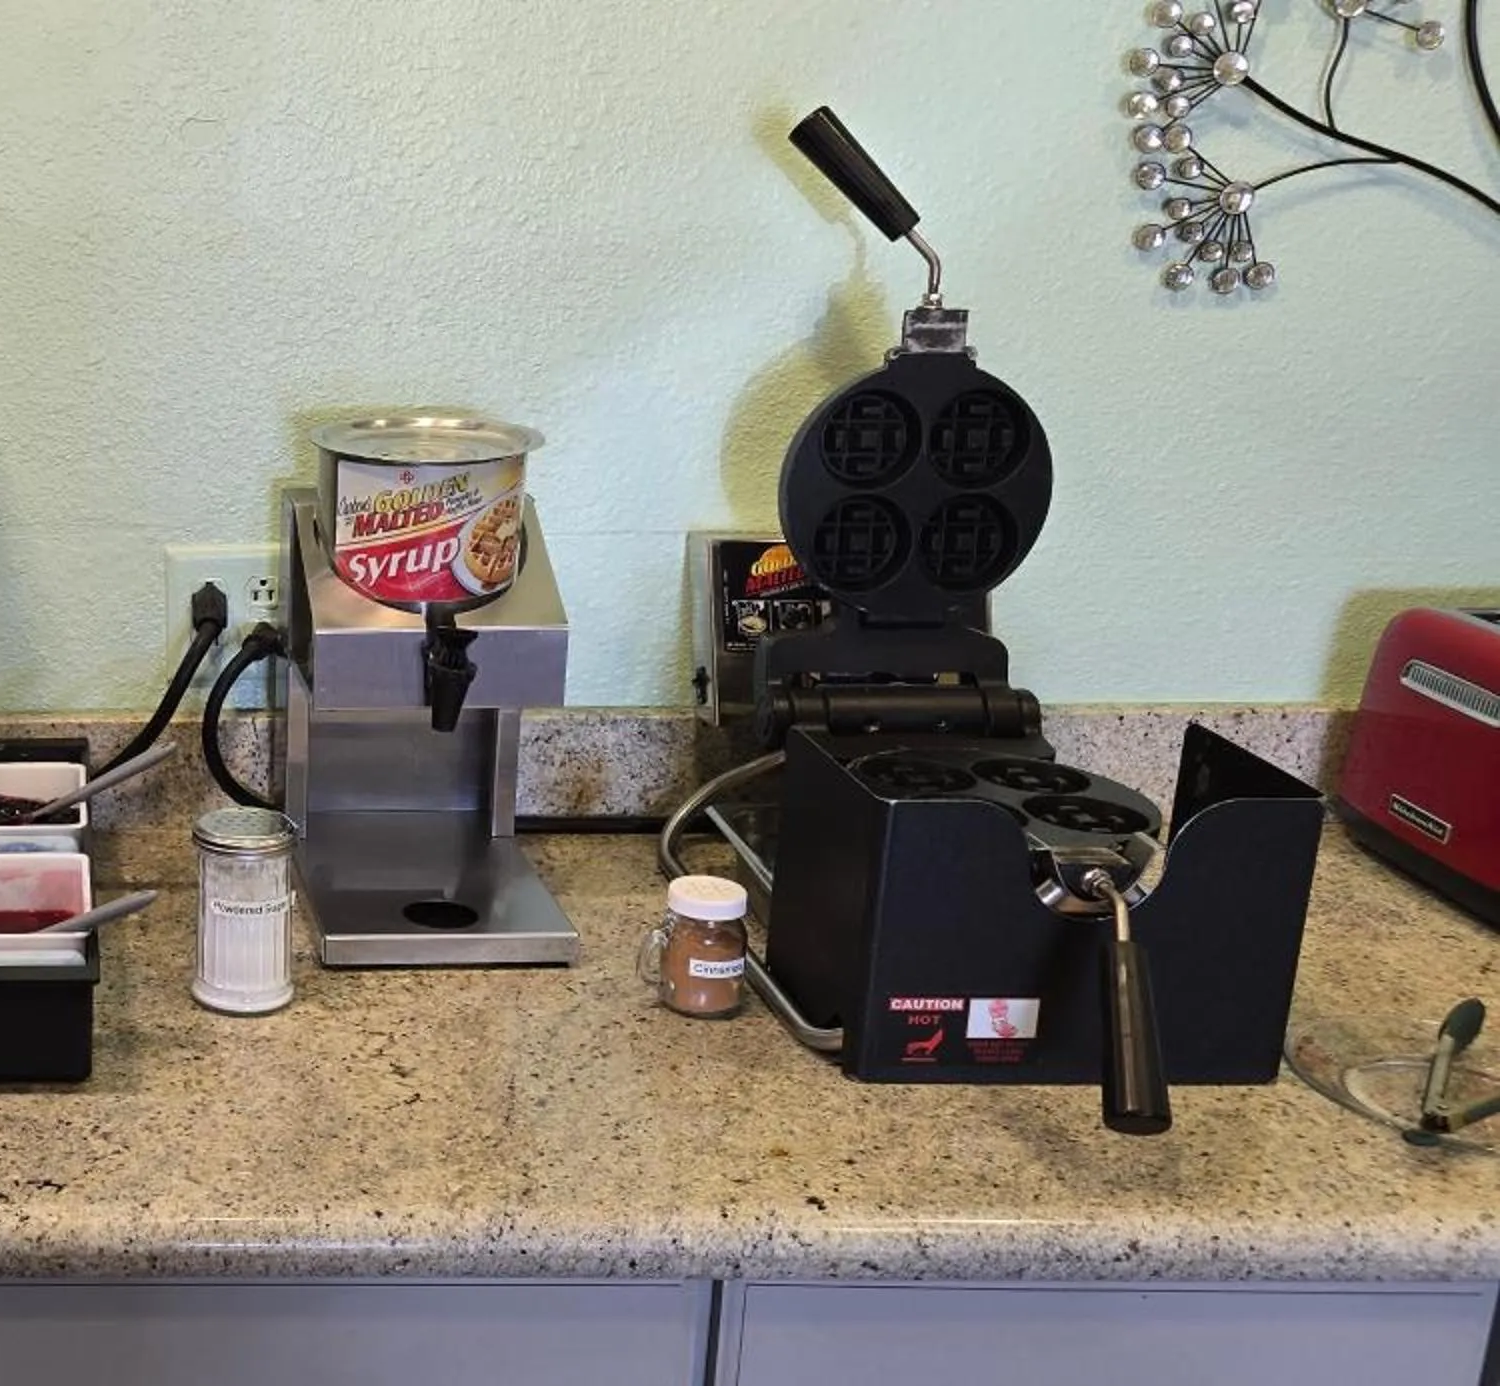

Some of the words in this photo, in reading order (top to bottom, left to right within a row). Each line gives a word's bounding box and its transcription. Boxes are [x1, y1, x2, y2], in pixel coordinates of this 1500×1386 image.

[373, 471, 471, 514] GOLDEN
[351, 499, 445, 539] MALTED
[348, 537, 460, 588] Syrup
[213, 900, 263, 915] Powdered
[890, 998, 965, 1011] CAUTION
[907, 1015, 943, 1025] HOT
